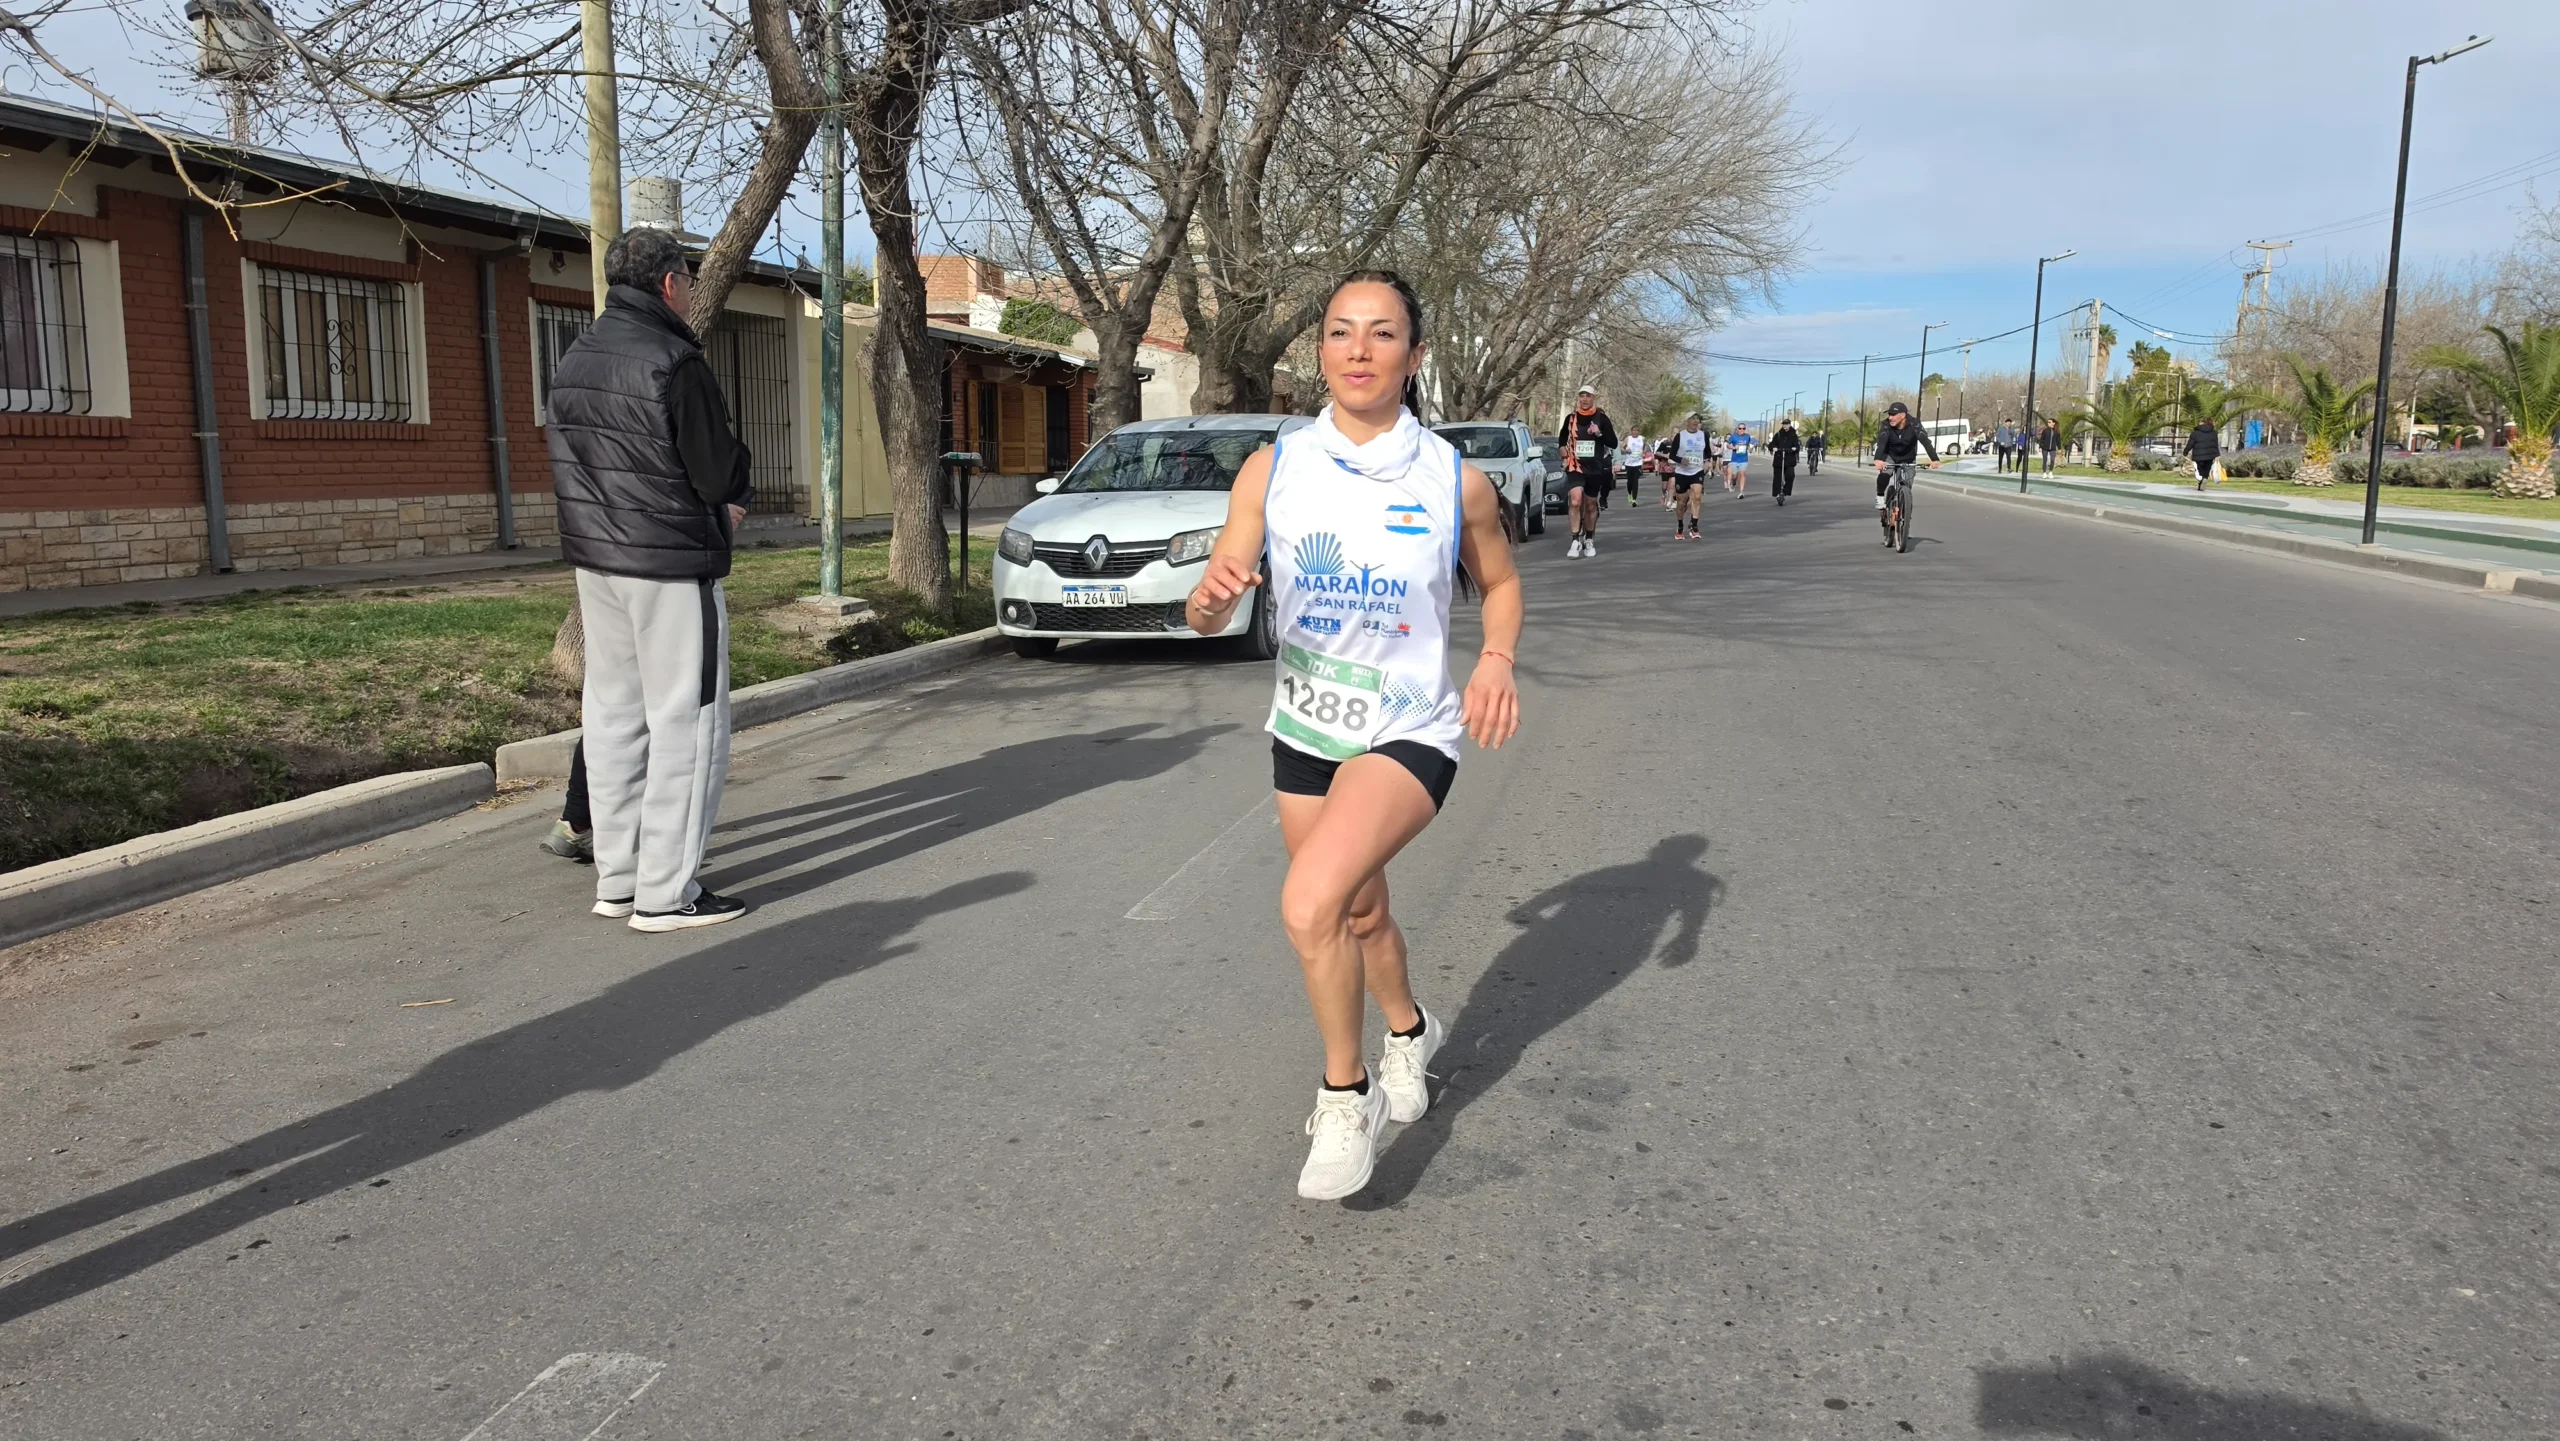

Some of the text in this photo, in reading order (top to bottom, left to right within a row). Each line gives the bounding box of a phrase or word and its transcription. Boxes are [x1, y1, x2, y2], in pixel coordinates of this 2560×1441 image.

[1066, 592, 1080, 605] AA
[1084, 592, 1105, 605] 264
[1315, 597, 1344, 609] SAN
[1348, 600, 1402, 614] RAFAEL
[1311, 616, 1341, 627] UTN
[1307, 658, 1340, 678] 10K
[1283, 675, 1369, 731] 1288
